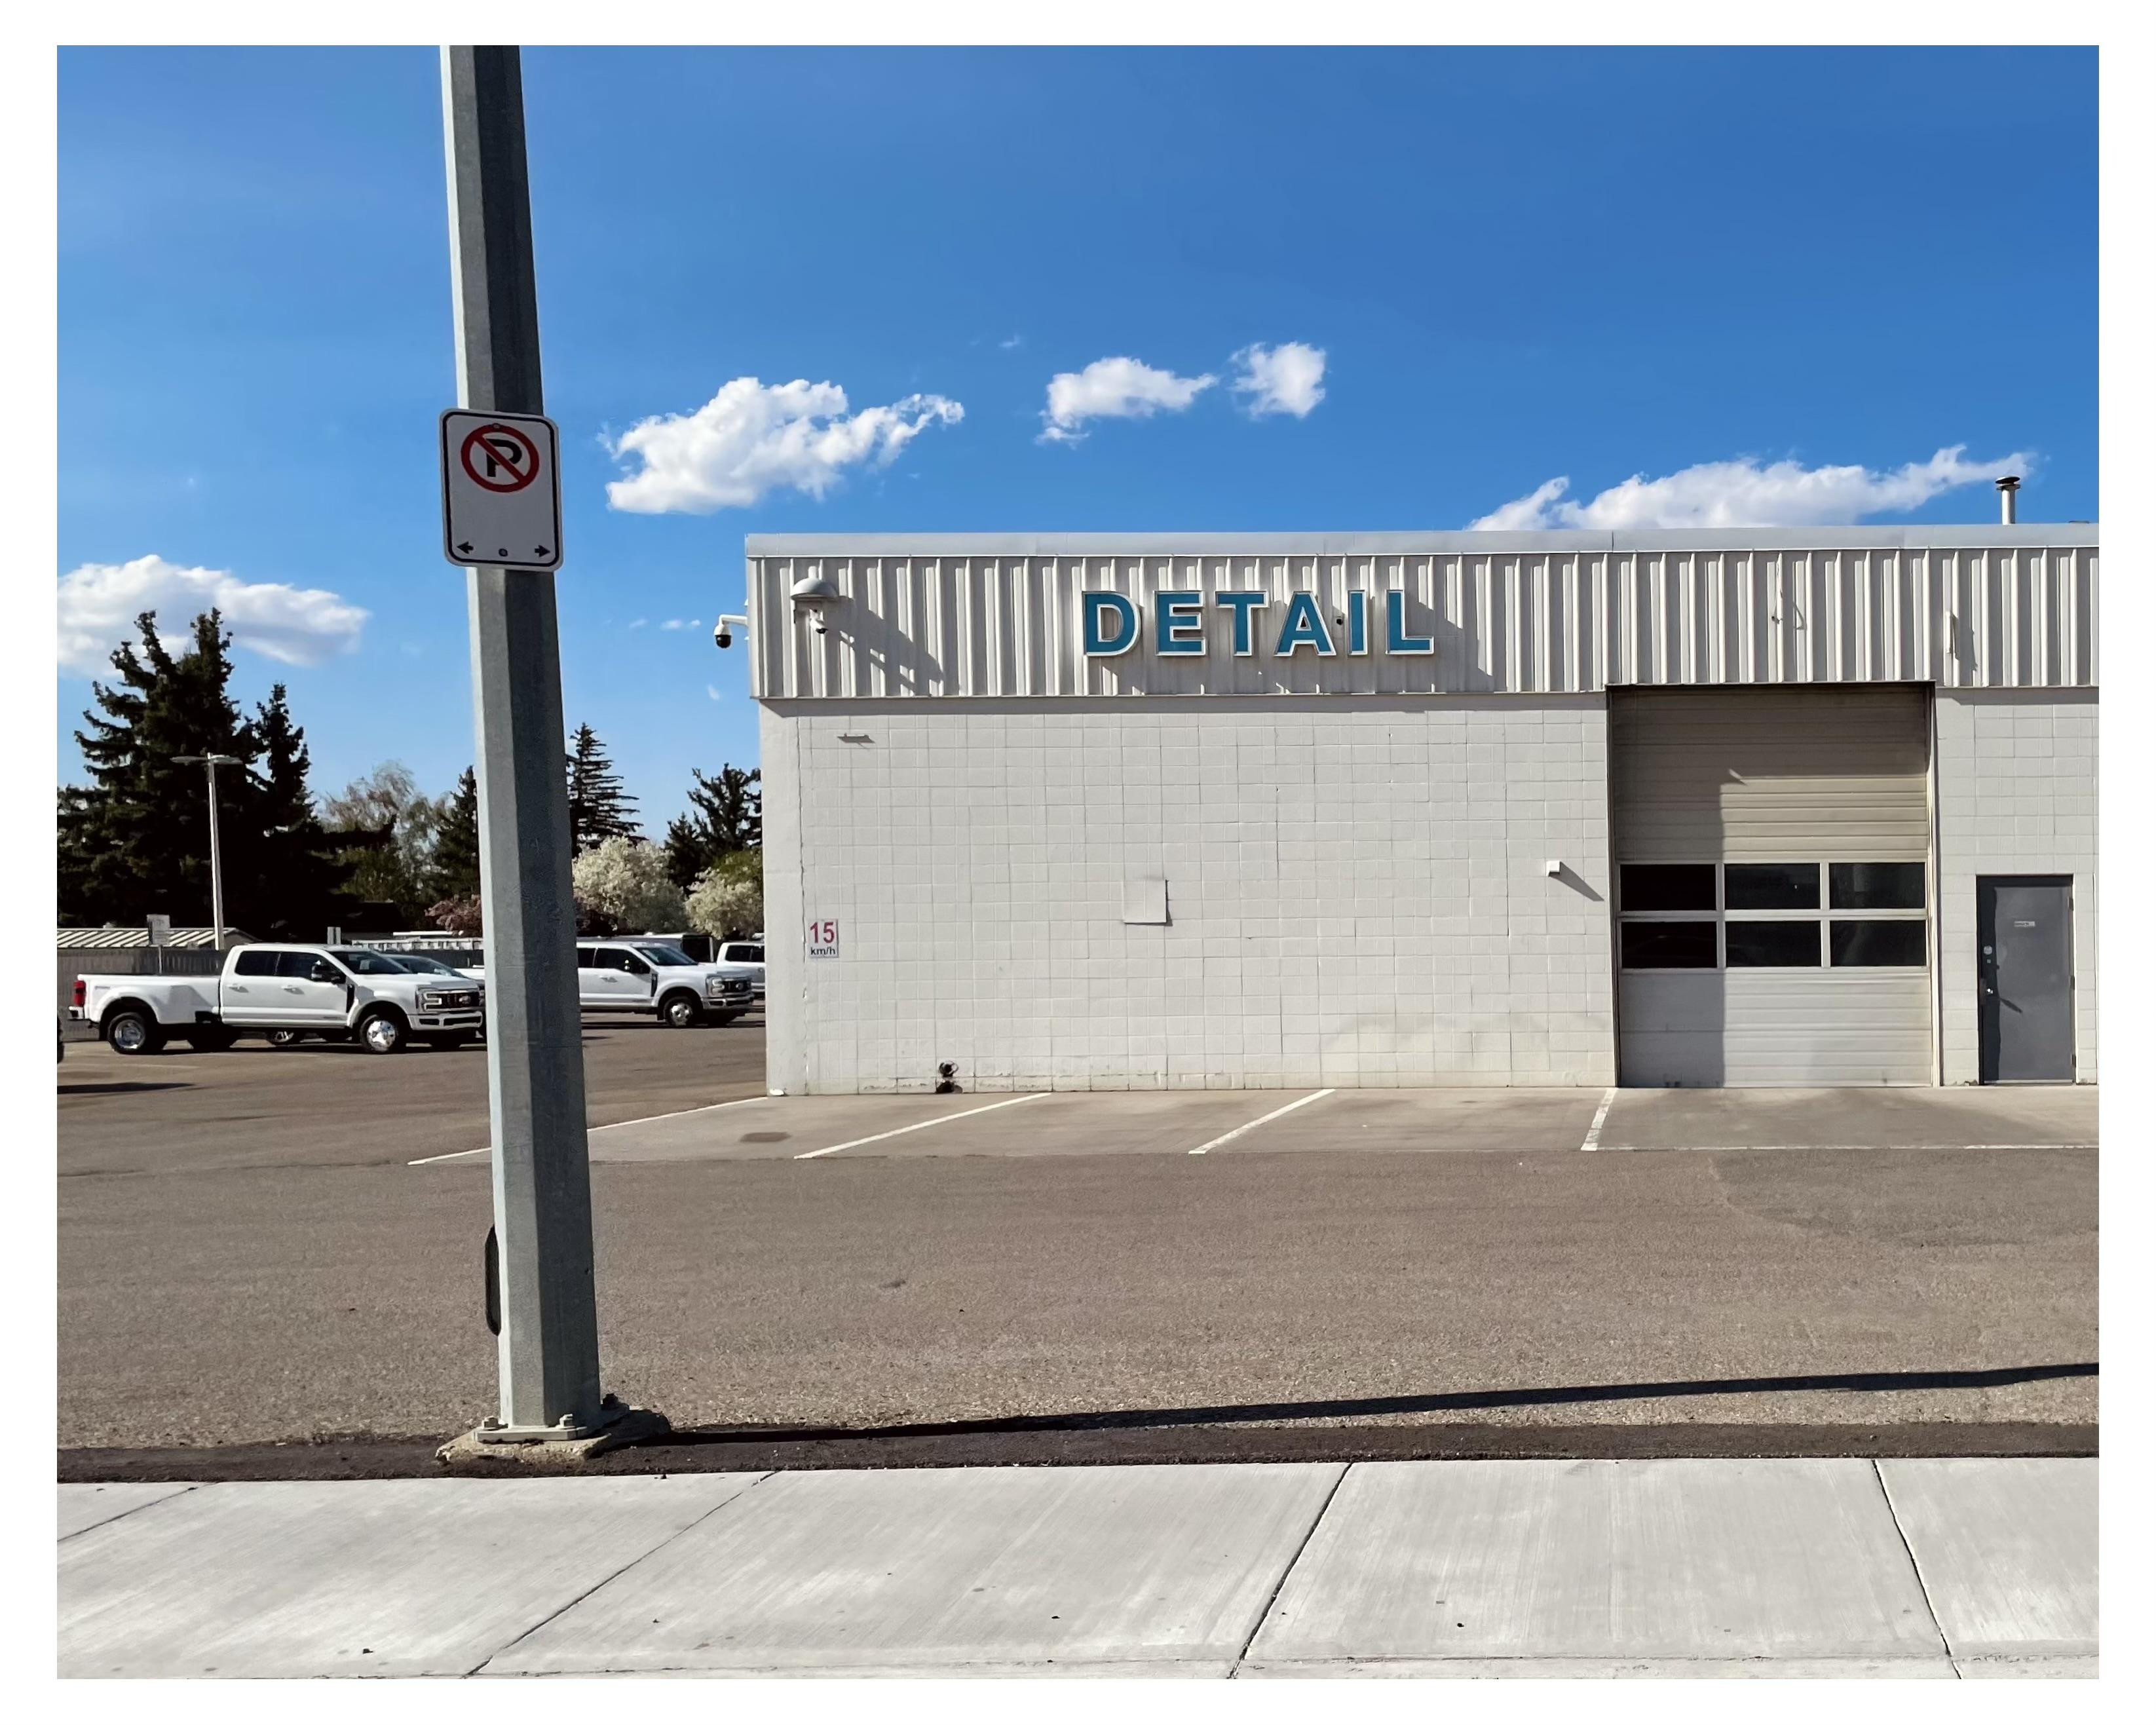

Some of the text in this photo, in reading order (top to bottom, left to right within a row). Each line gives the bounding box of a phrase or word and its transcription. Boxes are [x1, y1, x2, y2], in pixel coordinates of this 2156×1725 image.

[485, 438, 522, 478] P
[1082, 590, 1434, 656] DETAIL
[810, 921, 835, 944] 15
[810, 947, 835, 955] km/h
